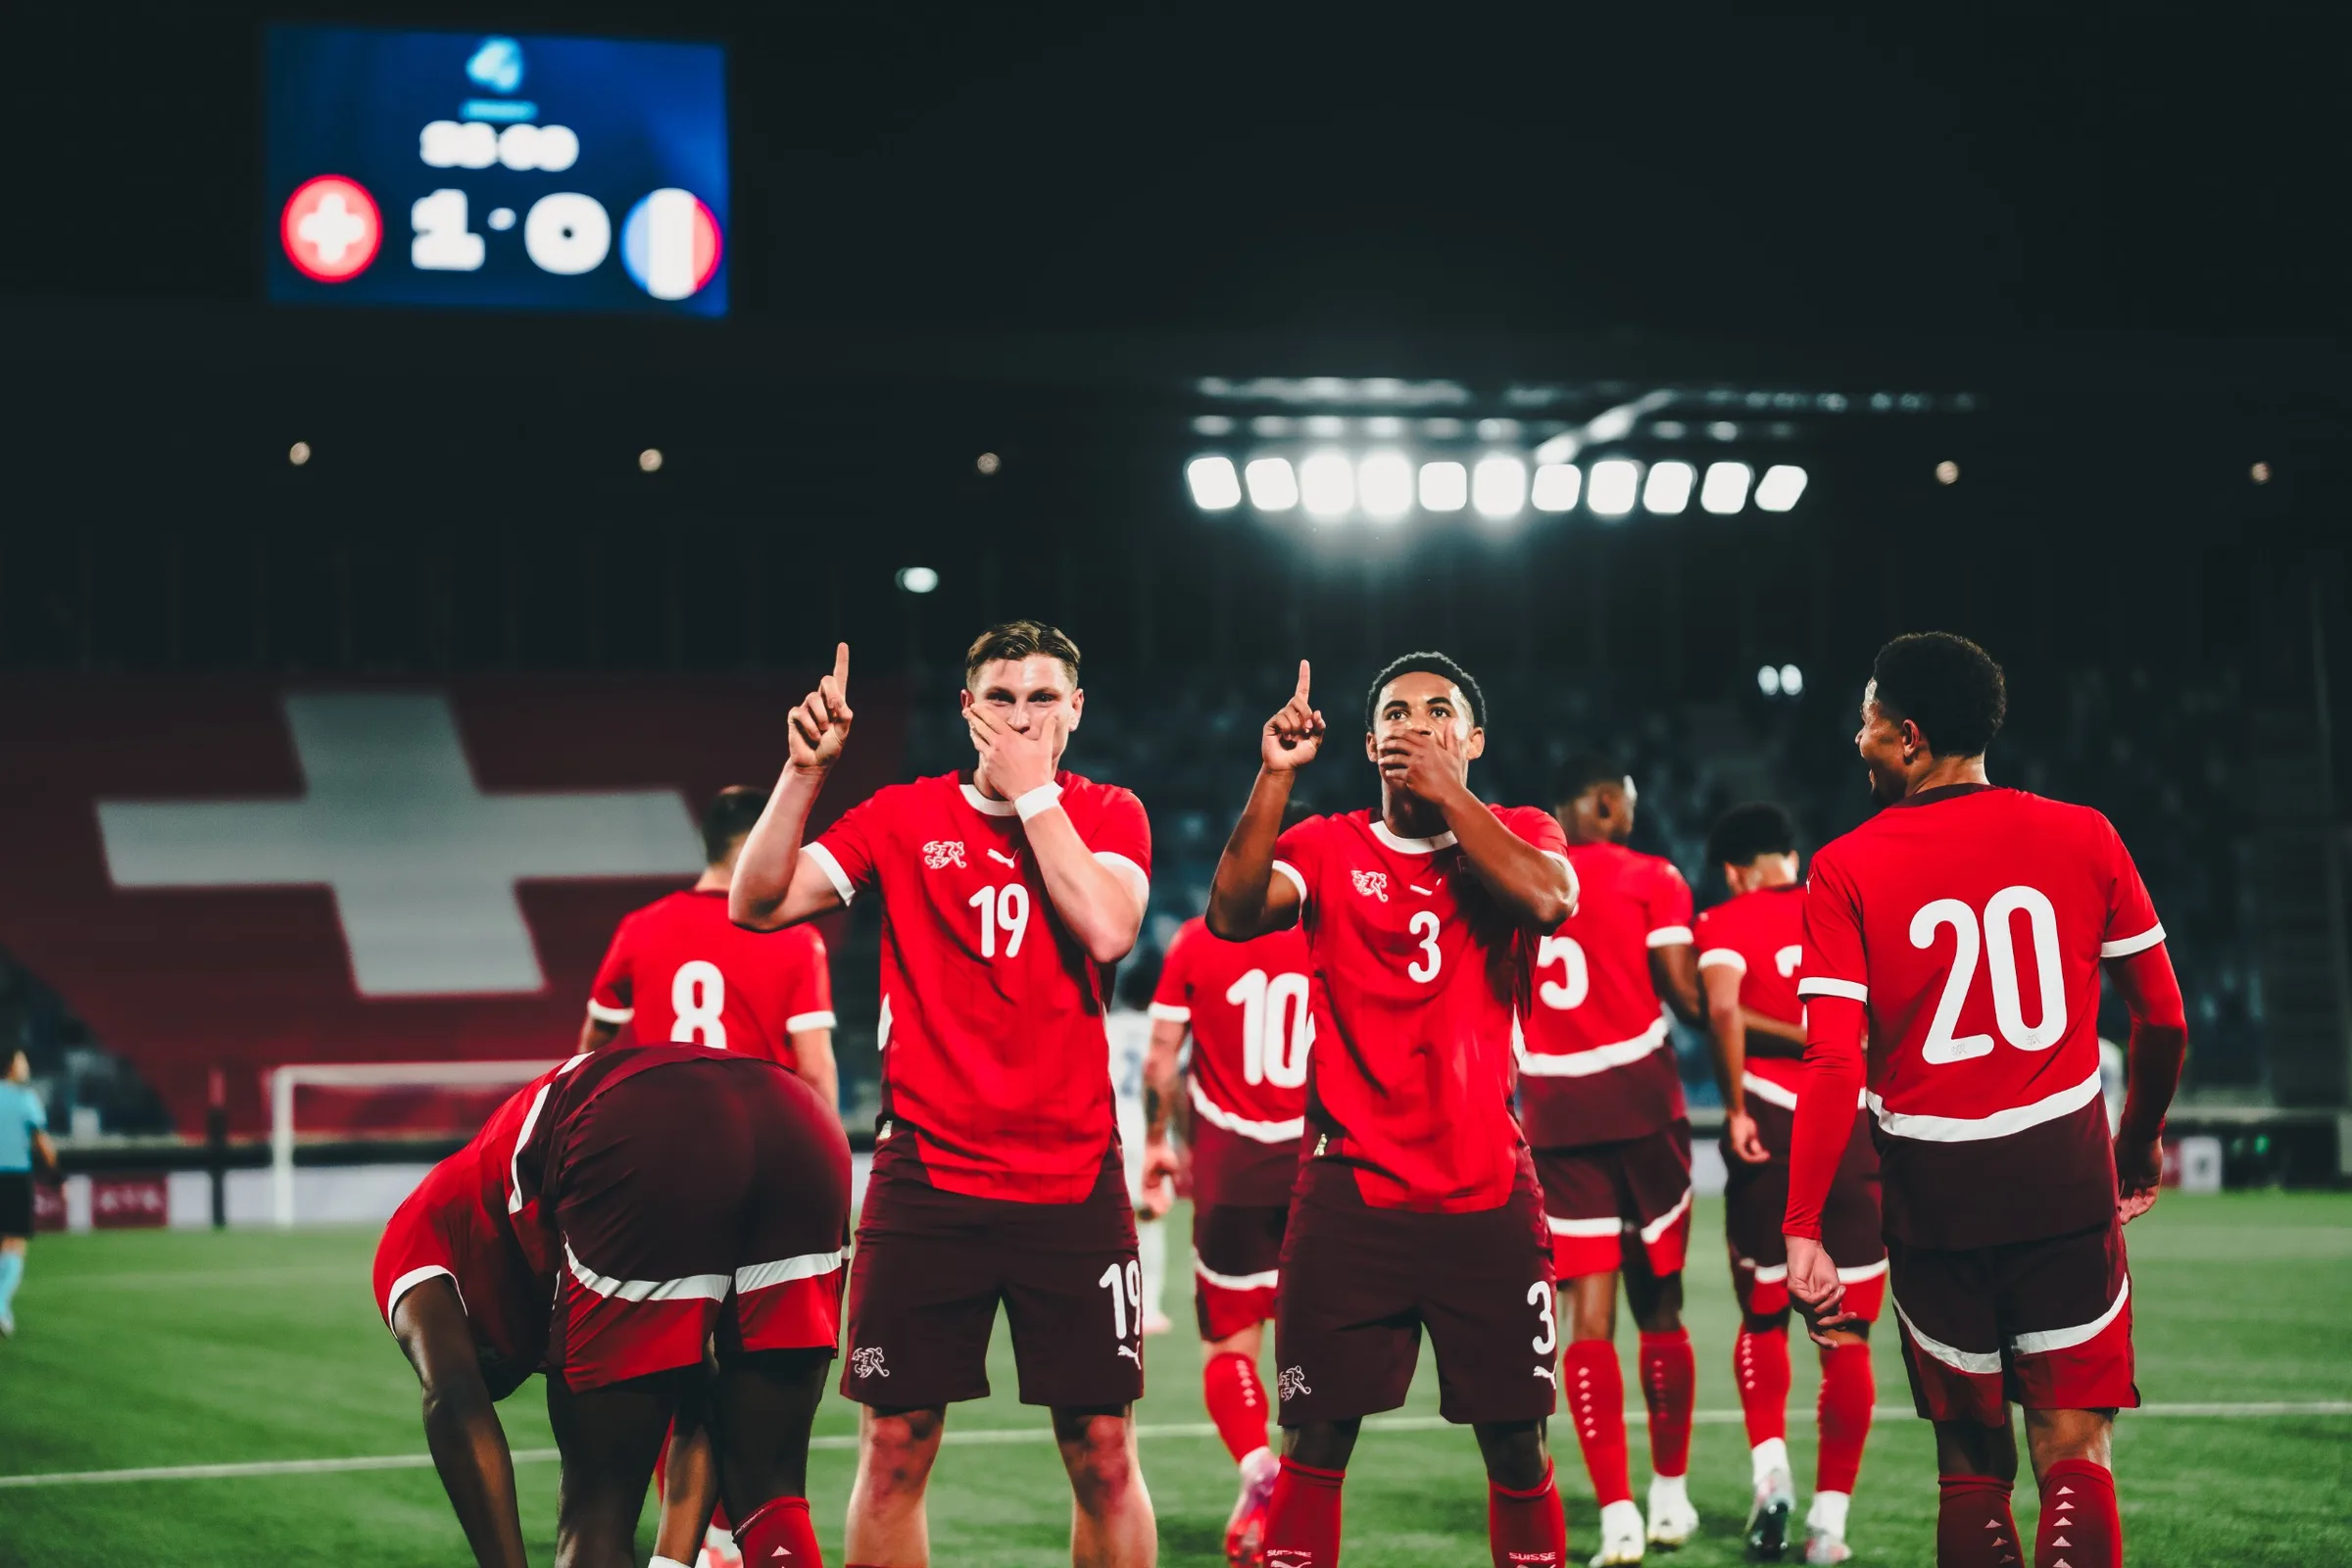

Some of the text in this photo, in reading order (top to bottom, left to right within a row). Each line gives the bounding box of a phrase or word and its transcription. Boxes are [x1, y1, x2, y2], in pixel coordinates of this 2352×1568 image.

[968, 883, 1030, 957] 19
[1407, 910, 1442, 983] 3
[669, 959, 727, 1050] 8
[1537, 935, 1589, 1010] 5
[1909, 885, 2068, 1064] 20
[1225, 967, 1309, 1089] 10
[1099, 1259, 1141, 1340] 19
[1527, 1280, 1556, 1355] 3
[1508, 1551, 1556, 1561] SUISSE
